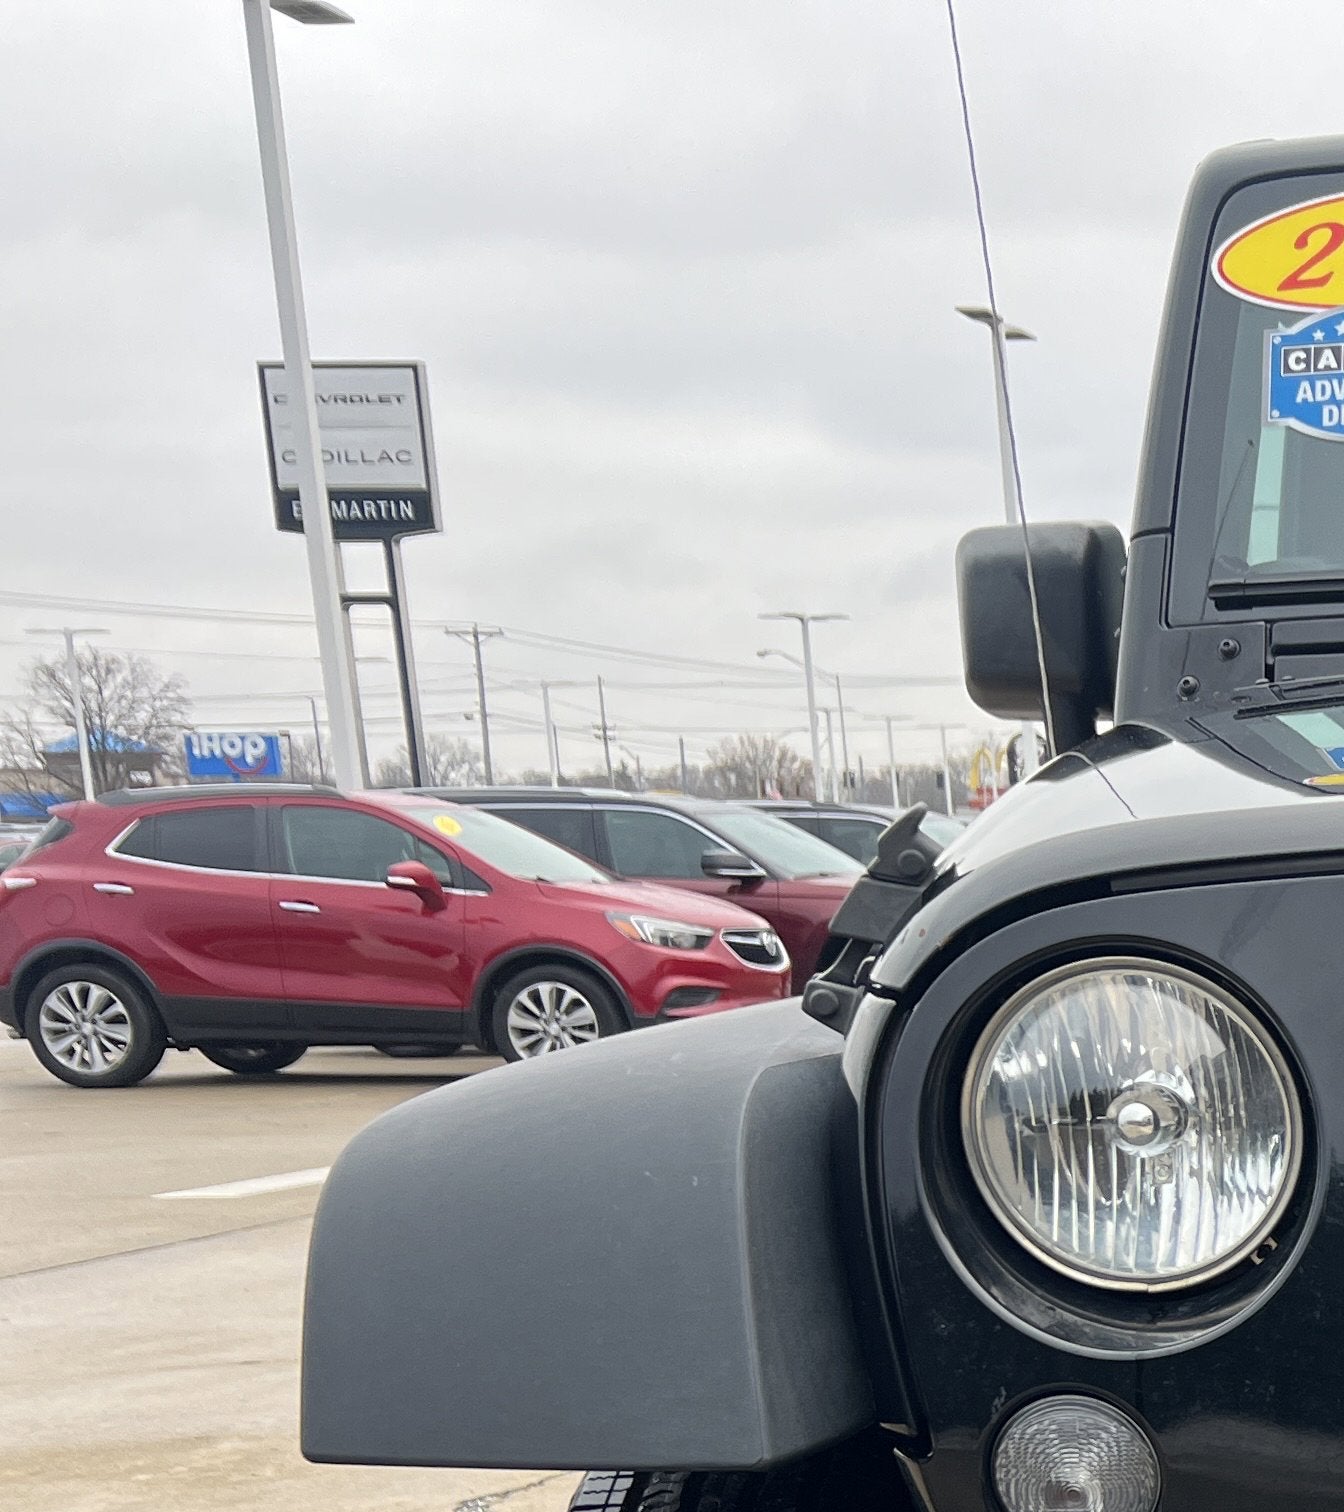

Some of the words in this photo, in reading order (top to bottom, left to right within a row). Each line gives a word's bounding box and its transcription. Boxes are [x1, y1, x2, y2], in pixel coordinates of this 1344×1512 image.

[273, 393, 406, 405] CVROLET
[281, 448, 415, 466] CDILLAC
[331, 499, 416, 522] MARTIN
